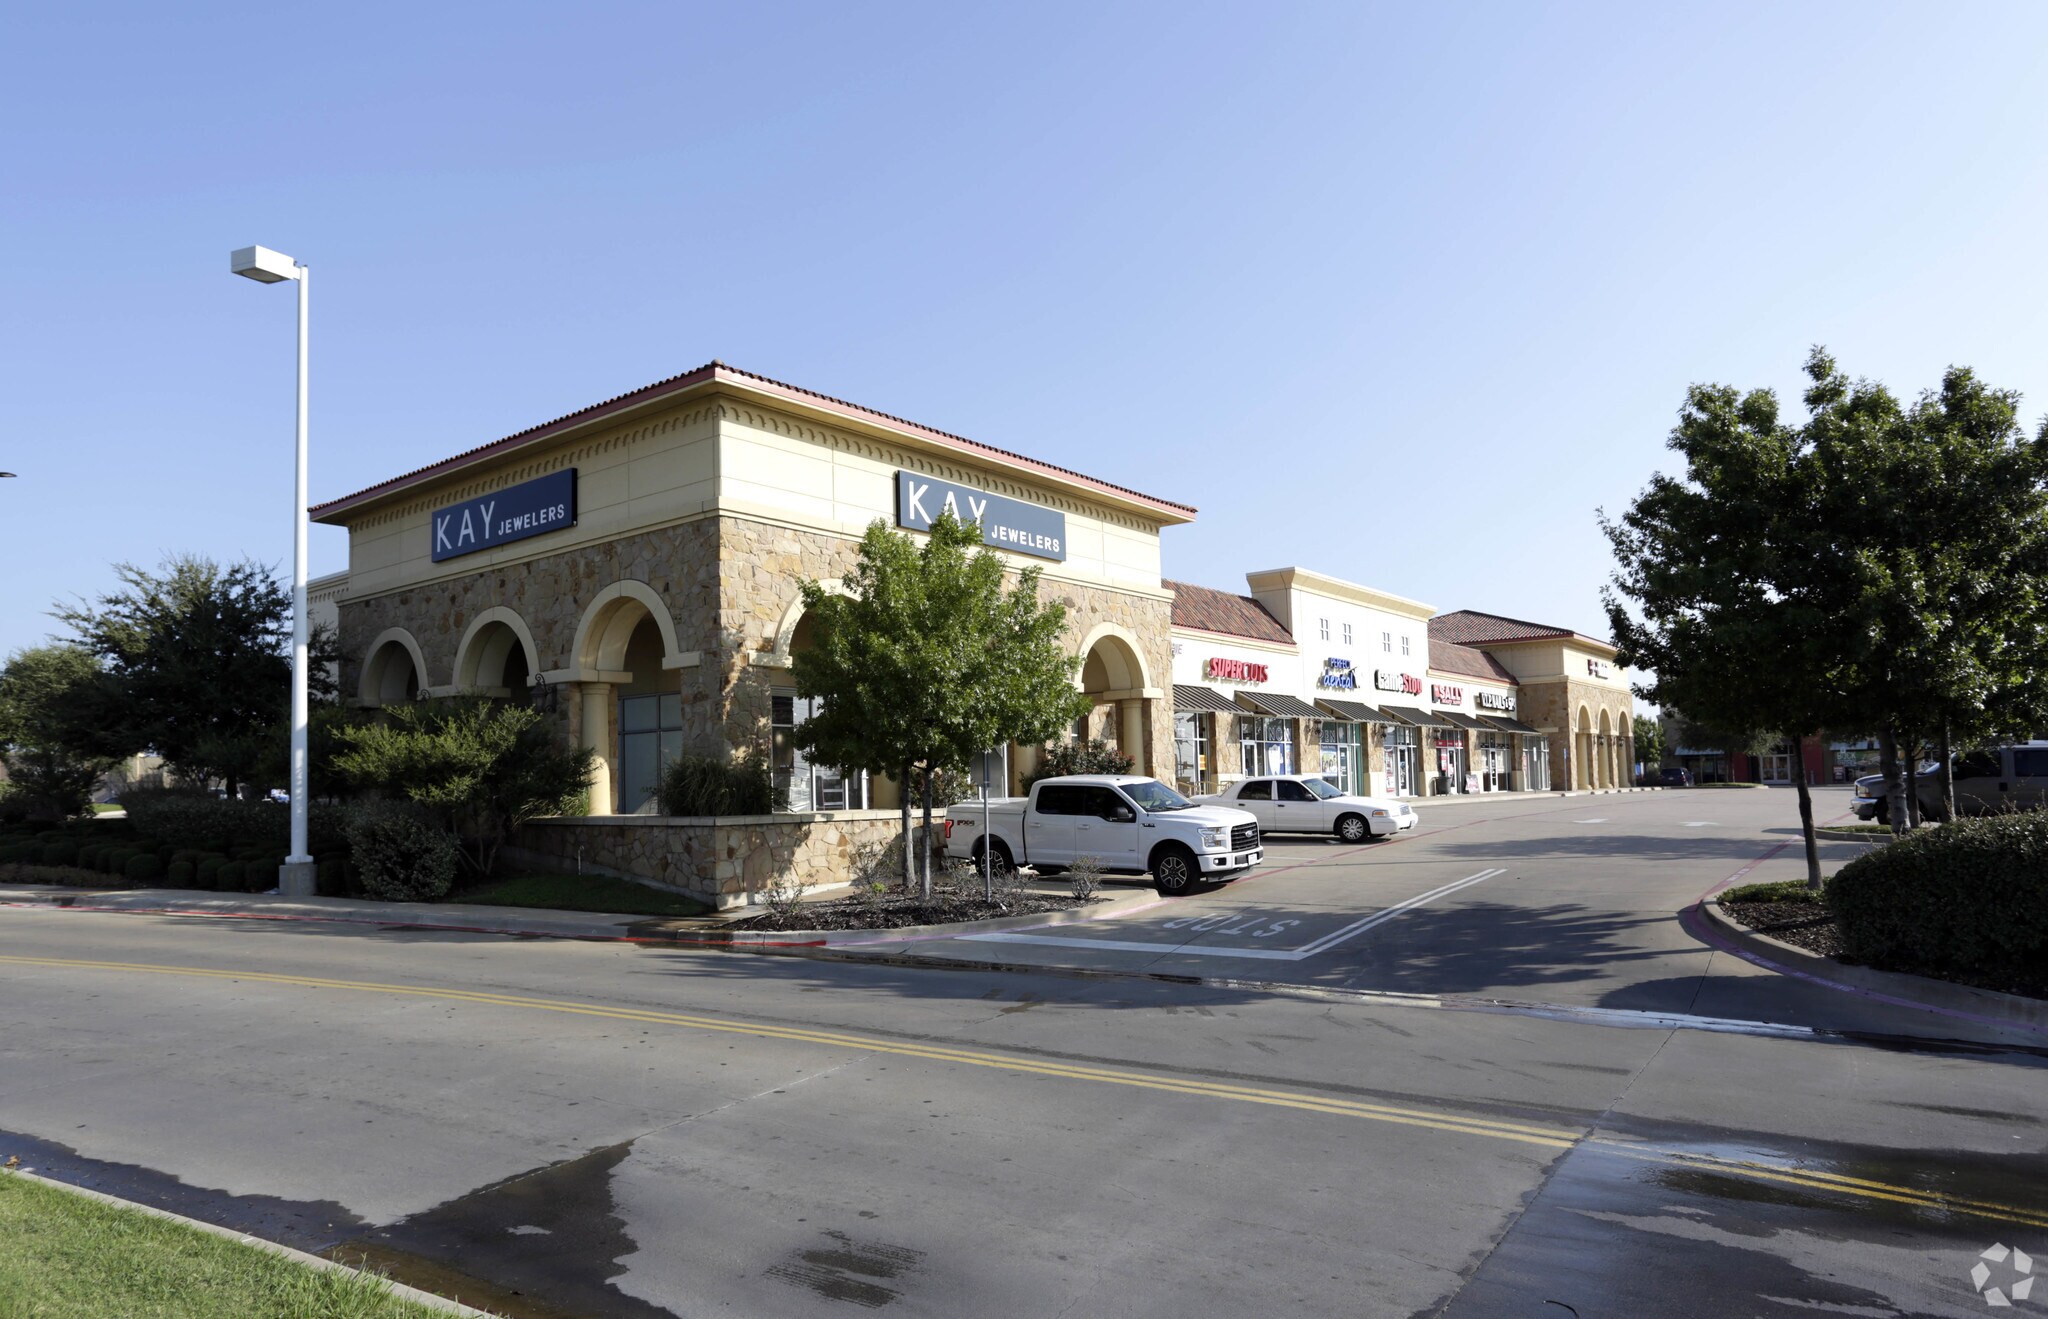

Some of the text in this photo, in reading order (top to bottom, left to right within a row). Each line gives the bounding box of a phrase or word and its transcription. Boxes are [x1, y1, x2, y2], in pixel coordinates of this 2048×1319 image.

[436, 500, 566, 553] KAY JEWELERS
[908, 480, 1061, 553] KAY JEWELERS
[1208, 656, 1269, 683] SUPERCUTS
[1376, 670, 1423, 695] GameStop
[1438, 685, 1464, 701] SALLY
[1162, 913, 1301, 938] STOP
